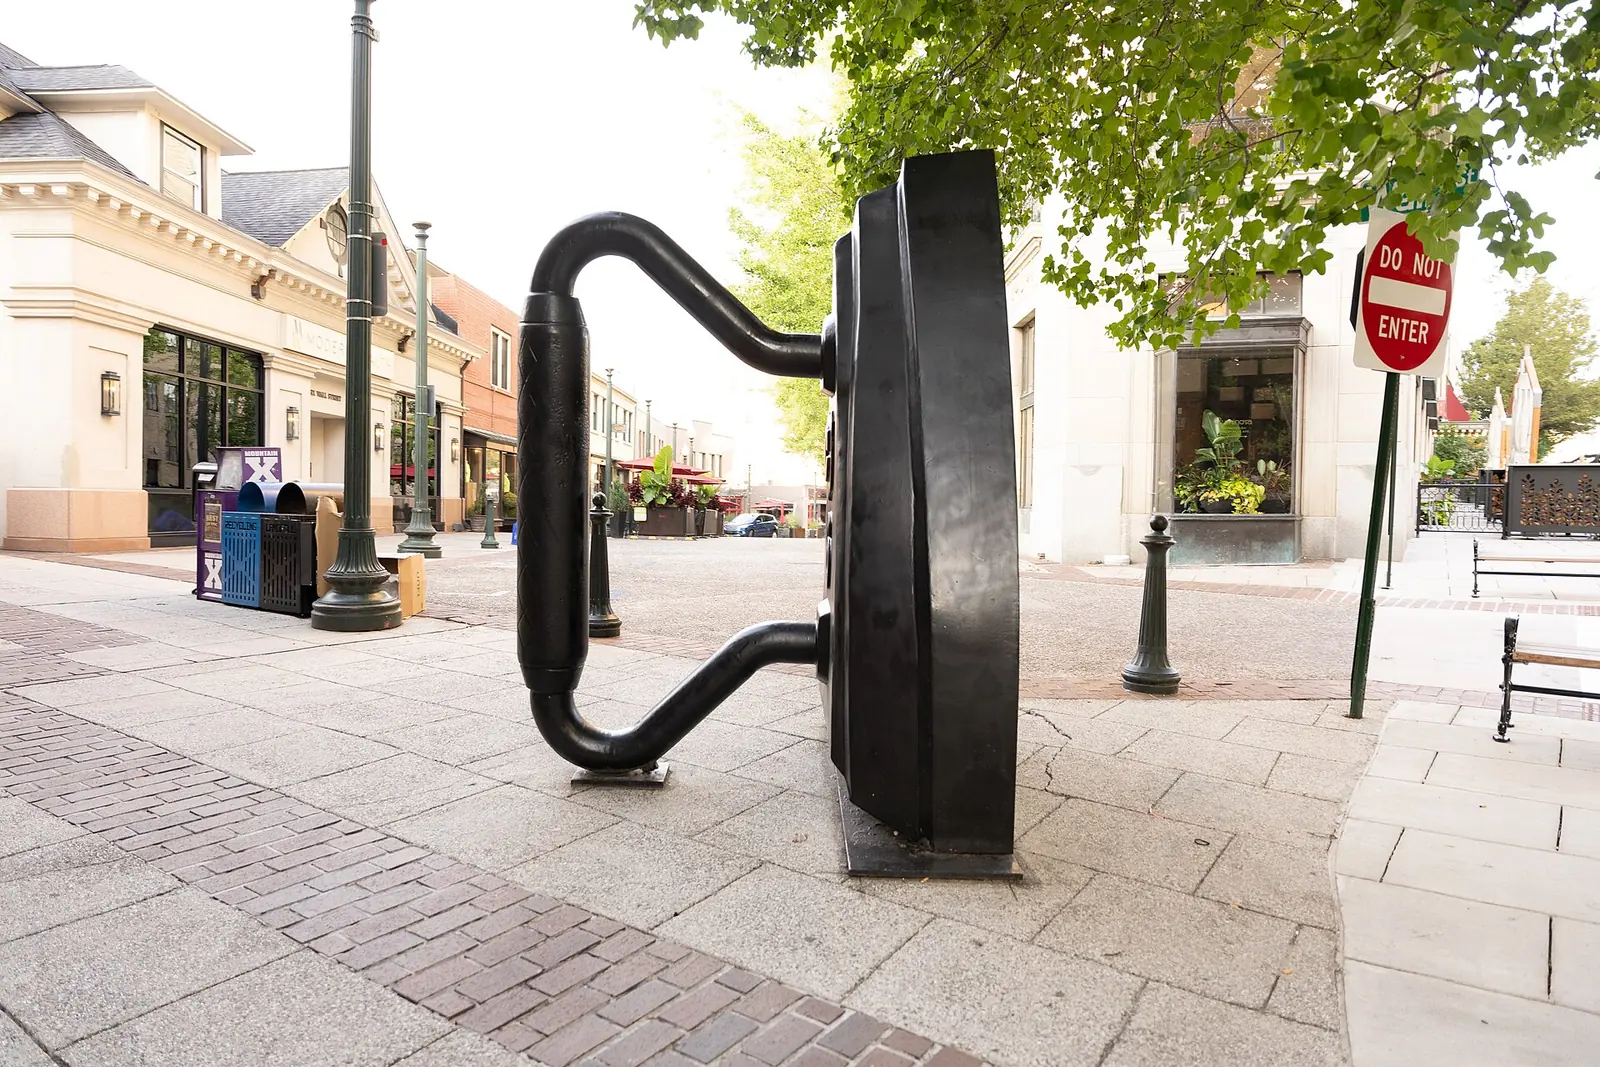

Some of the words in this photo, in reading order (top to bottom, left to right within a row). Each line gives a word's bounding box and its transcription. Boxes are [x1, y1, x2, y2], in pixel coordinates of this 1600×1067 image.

[1380, 244, 1402, 271] DO
[1412, 252, 1444, 280] NOT
[1378, 314, 1429, 345] ENTER
[224, 520, 258, 531] RECYCLING
